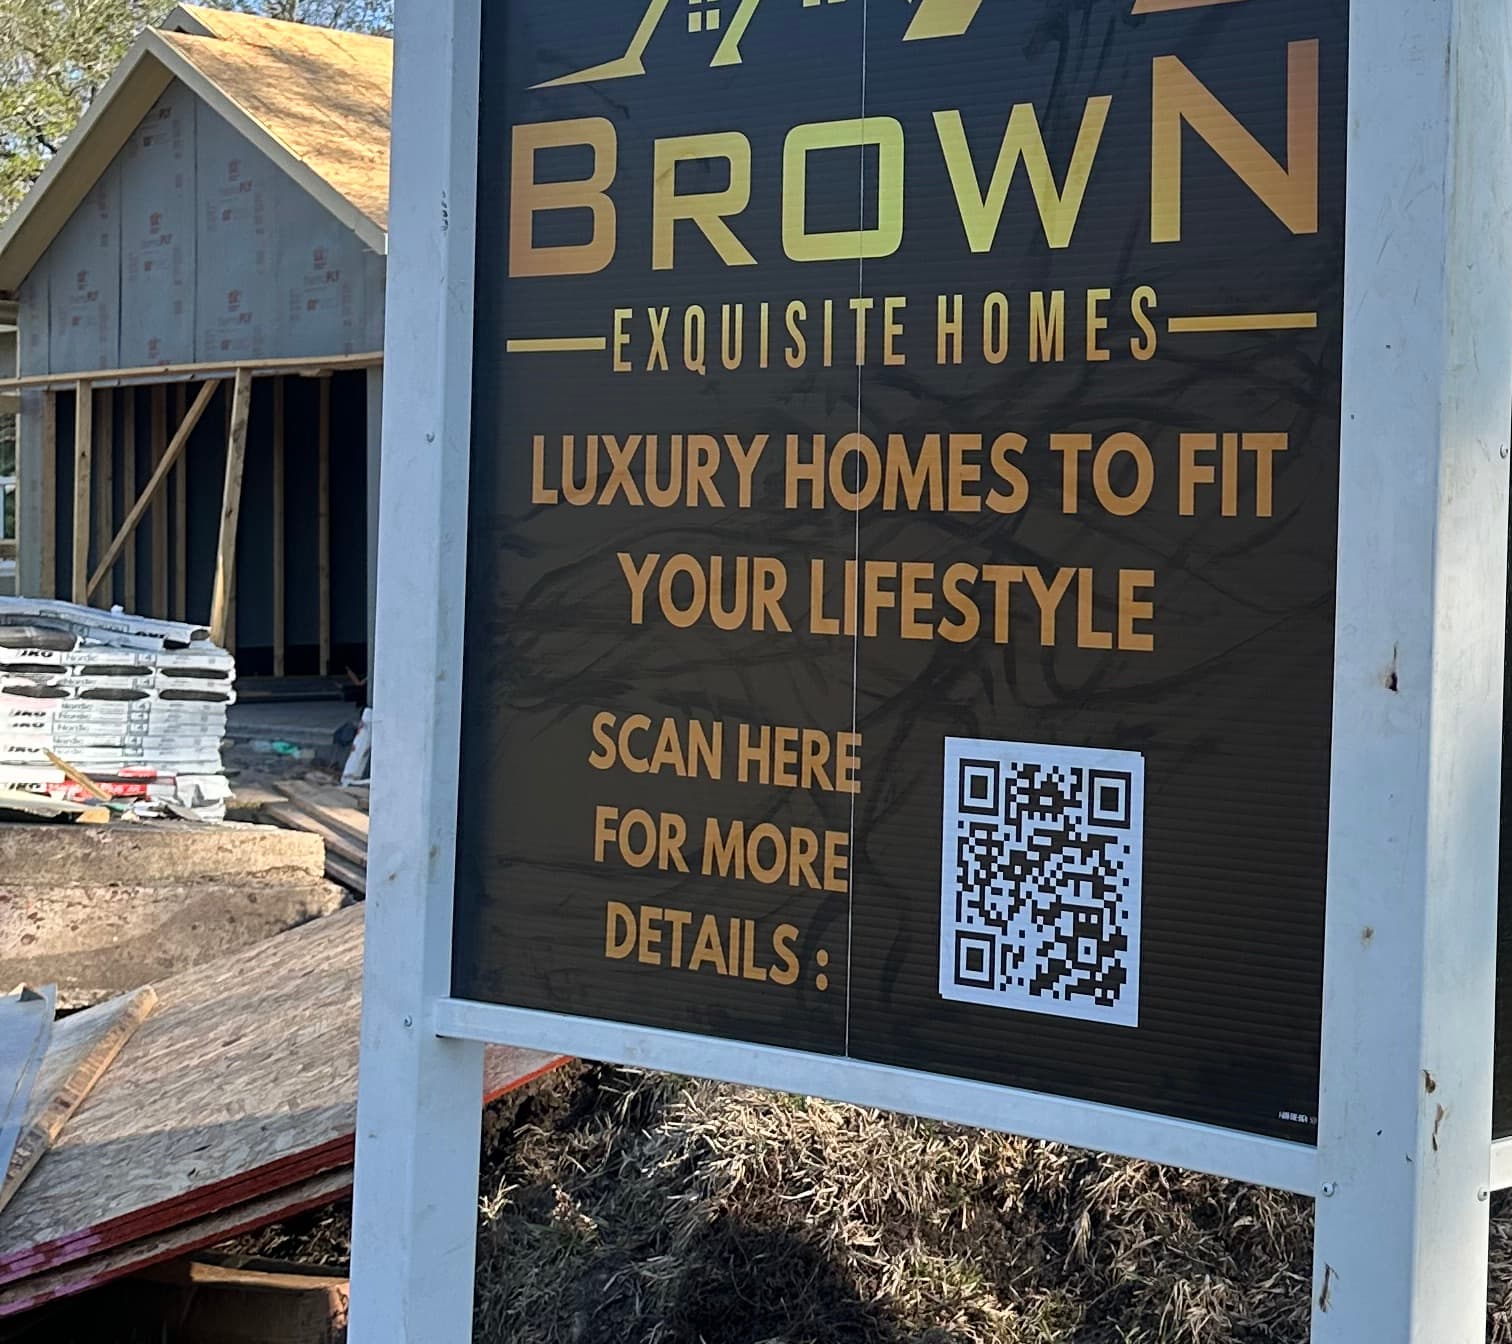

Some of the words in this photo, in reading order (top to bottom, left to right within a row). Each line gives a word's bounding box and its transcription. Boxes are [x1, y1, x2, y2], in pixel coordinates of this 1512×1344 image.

[510, 40, 1319, 277] BROWN
[614, 295, 908, 373] EXQUISITE
[937, 285, 1159, 365] HOMES
[531, 434, 770, 507] LUXURY
[785, 433, 1029, 514] HOMES
[1050, 432, 1155, 516] TO
[1179, 432, 1289, 517] FIT
[617, 552, 793, 634] YOUR
[809, 559, 1156, 651] LIFESTYLE
[588, 711, 723, 780] SCAN
[737, 725, 862, 794] HERE
[594, 806, 690, 873] FOR
[701, 816, 850, 893] MORE
